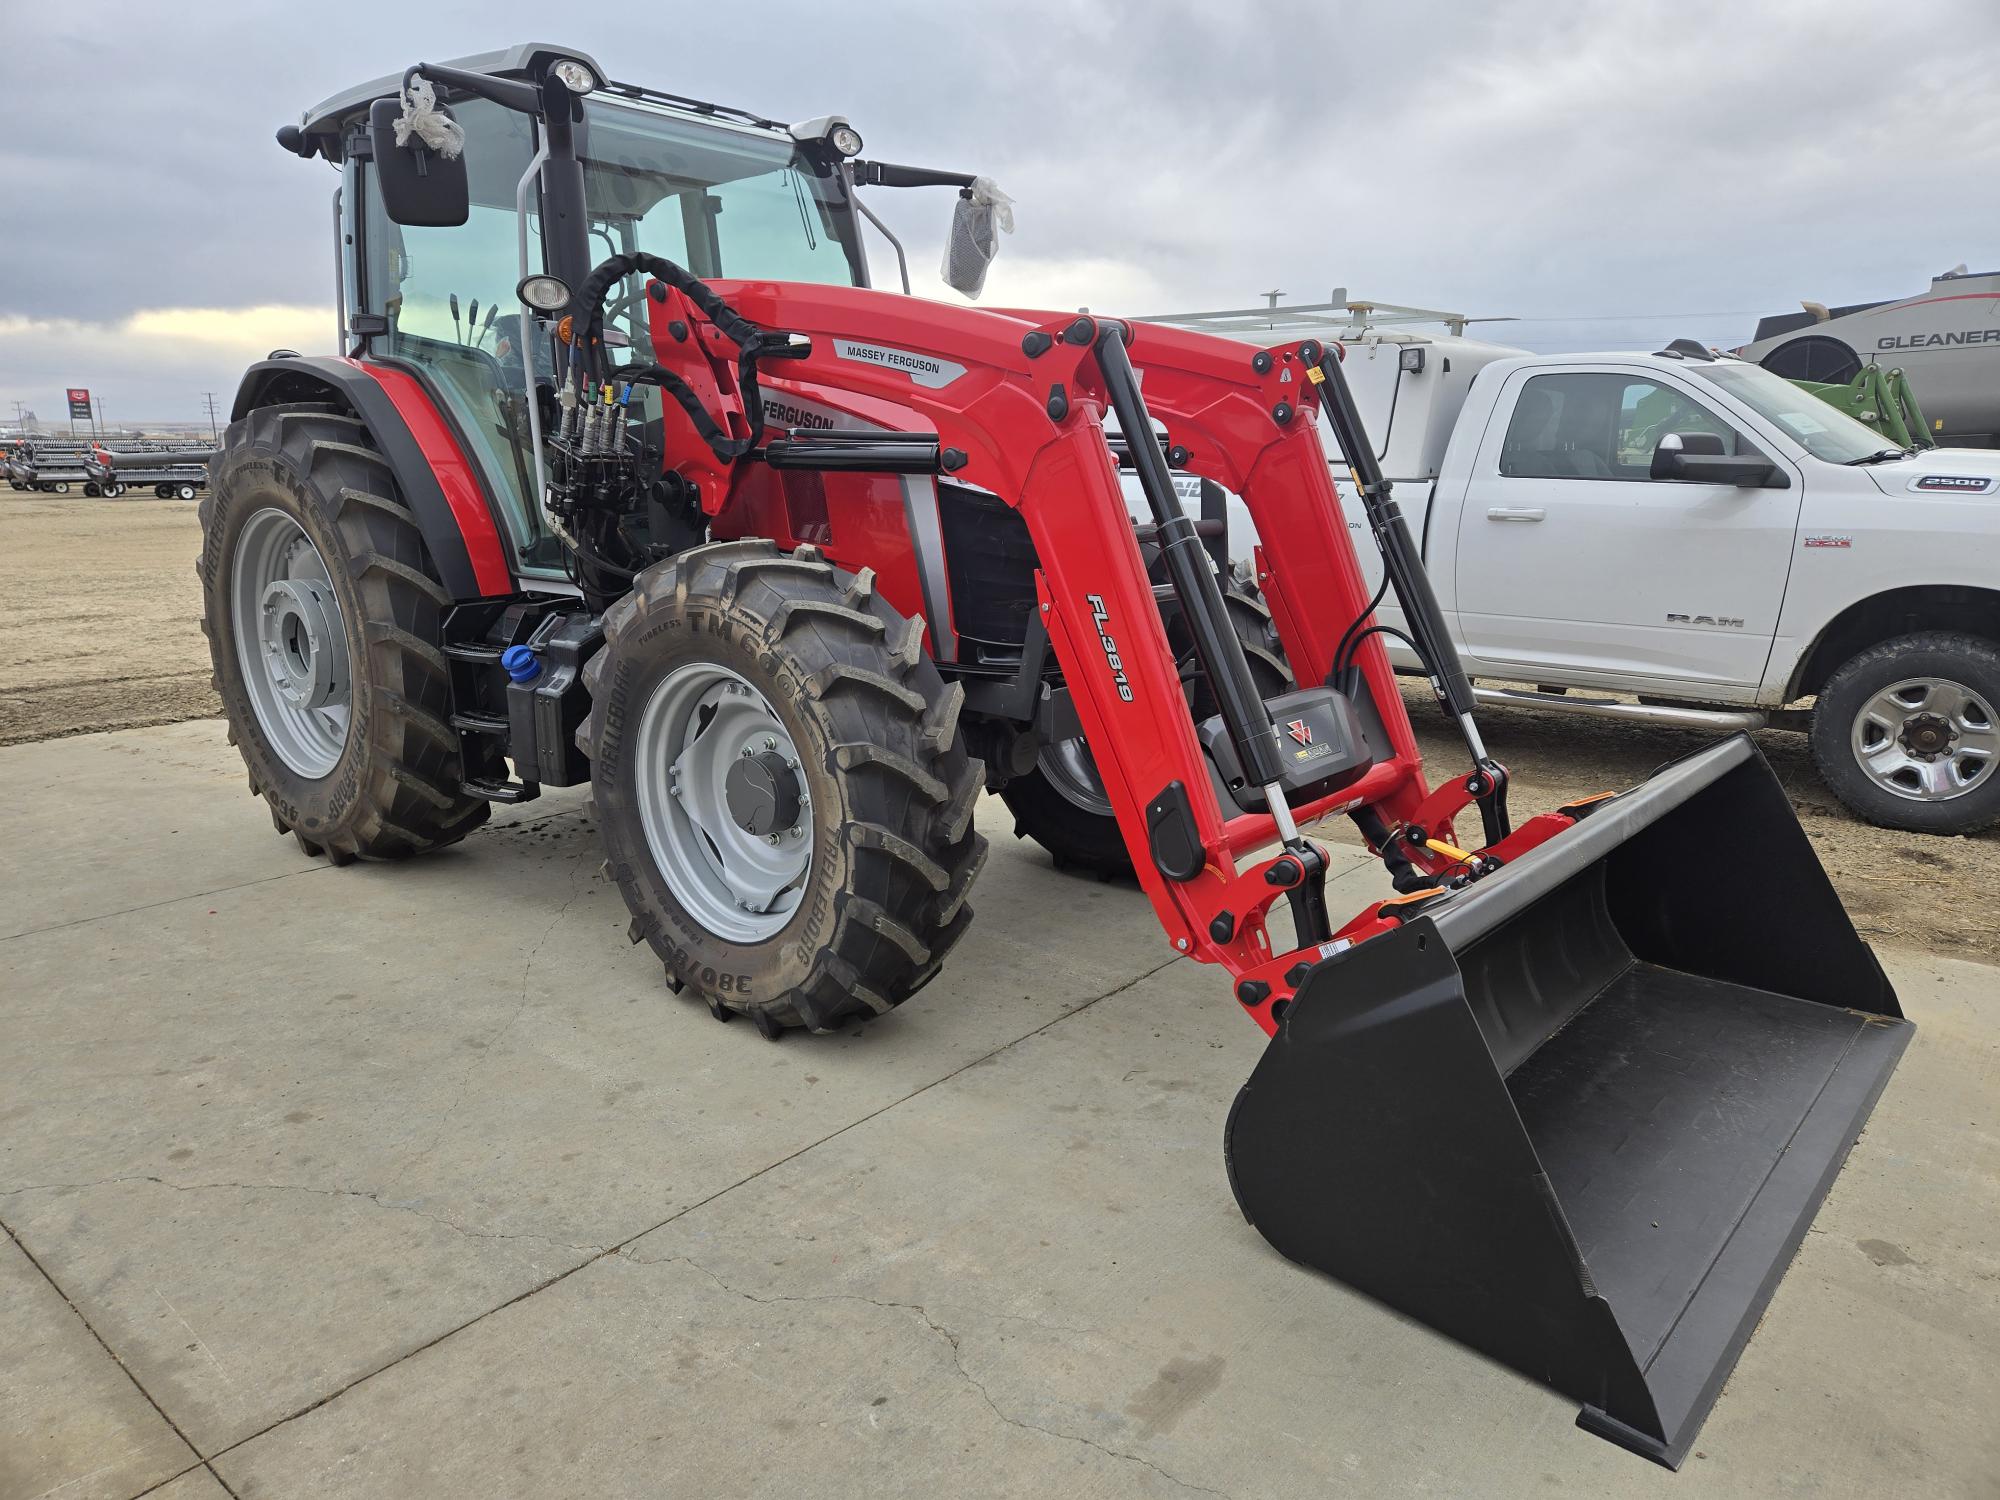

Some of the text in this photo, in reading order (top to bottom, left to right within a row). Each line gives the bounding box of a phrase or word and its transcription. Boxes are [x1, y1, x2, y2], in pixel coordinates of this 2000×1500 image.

[1878, 329, 2000, 349] GLEANER
[847, 346, 940, 374] MASSEY FERGUSON
[763, 399, 834, 429] FERGUSON
[1925, 478, 1985, 487] 2500
[204, 478, 234, 592] TRELLEBORG
[638, 618, 682, 647] TUBELESS
[1666, 613, 1745, 628] RAM
[1086, 593, 1134, 703] FL.3819
[600, 657, 632, 788] TRELLEBORG
[796, 825, 841, 968] TRELLEBORG
